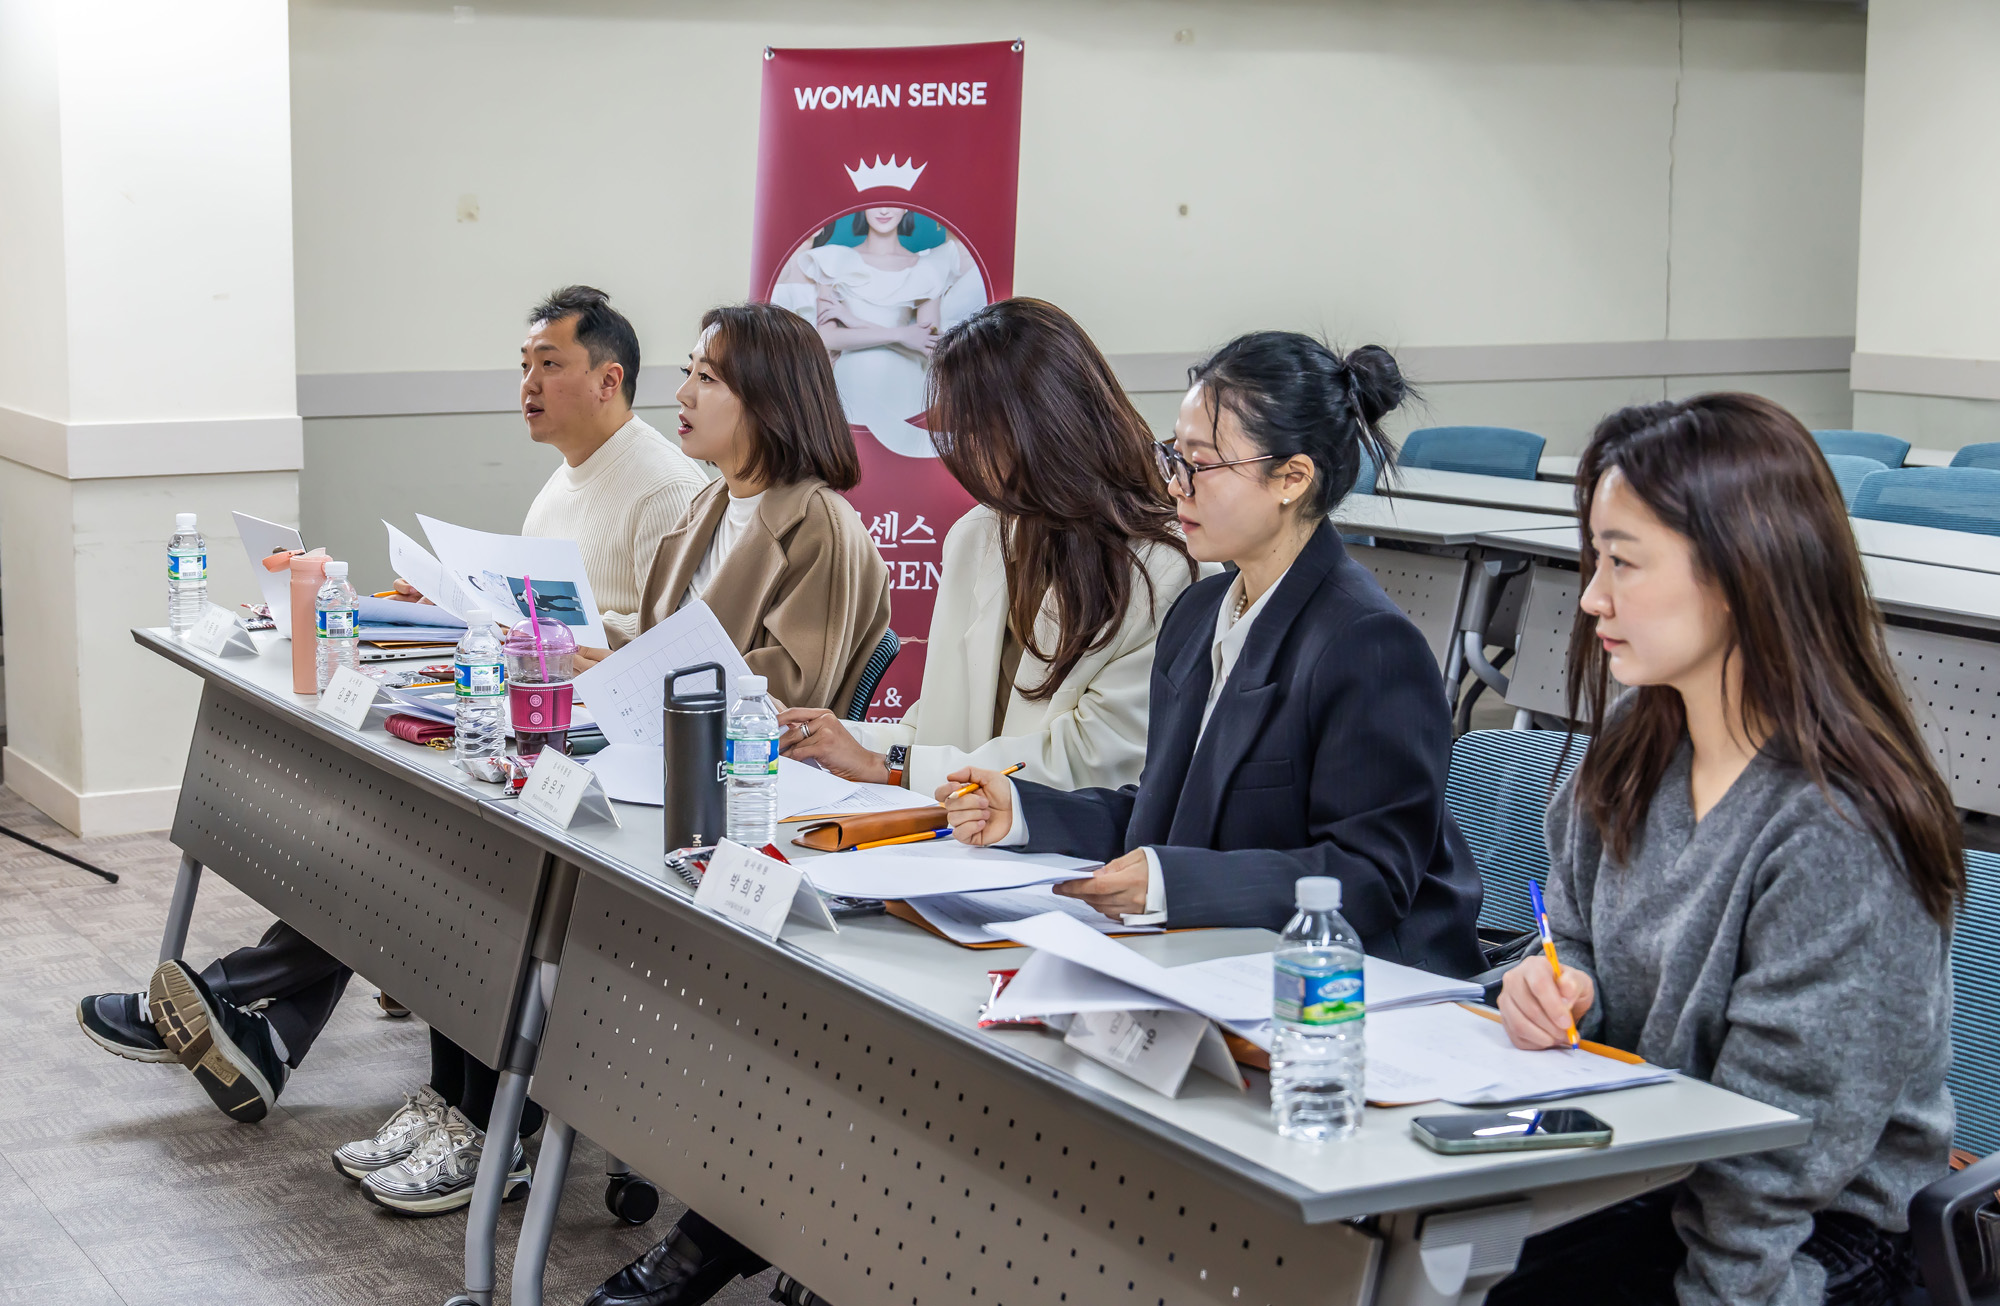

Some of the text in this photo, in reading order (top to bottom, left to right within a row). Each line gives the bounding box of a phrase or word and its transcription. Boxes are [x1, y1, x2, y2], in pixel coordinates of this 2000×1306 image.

[793, 82, 987, 110] WOMAN SENSE
[855, 510, 937, 549] 센스
[884, 686, 903, 708] &
[729, 872, 767, 903] 박희경
